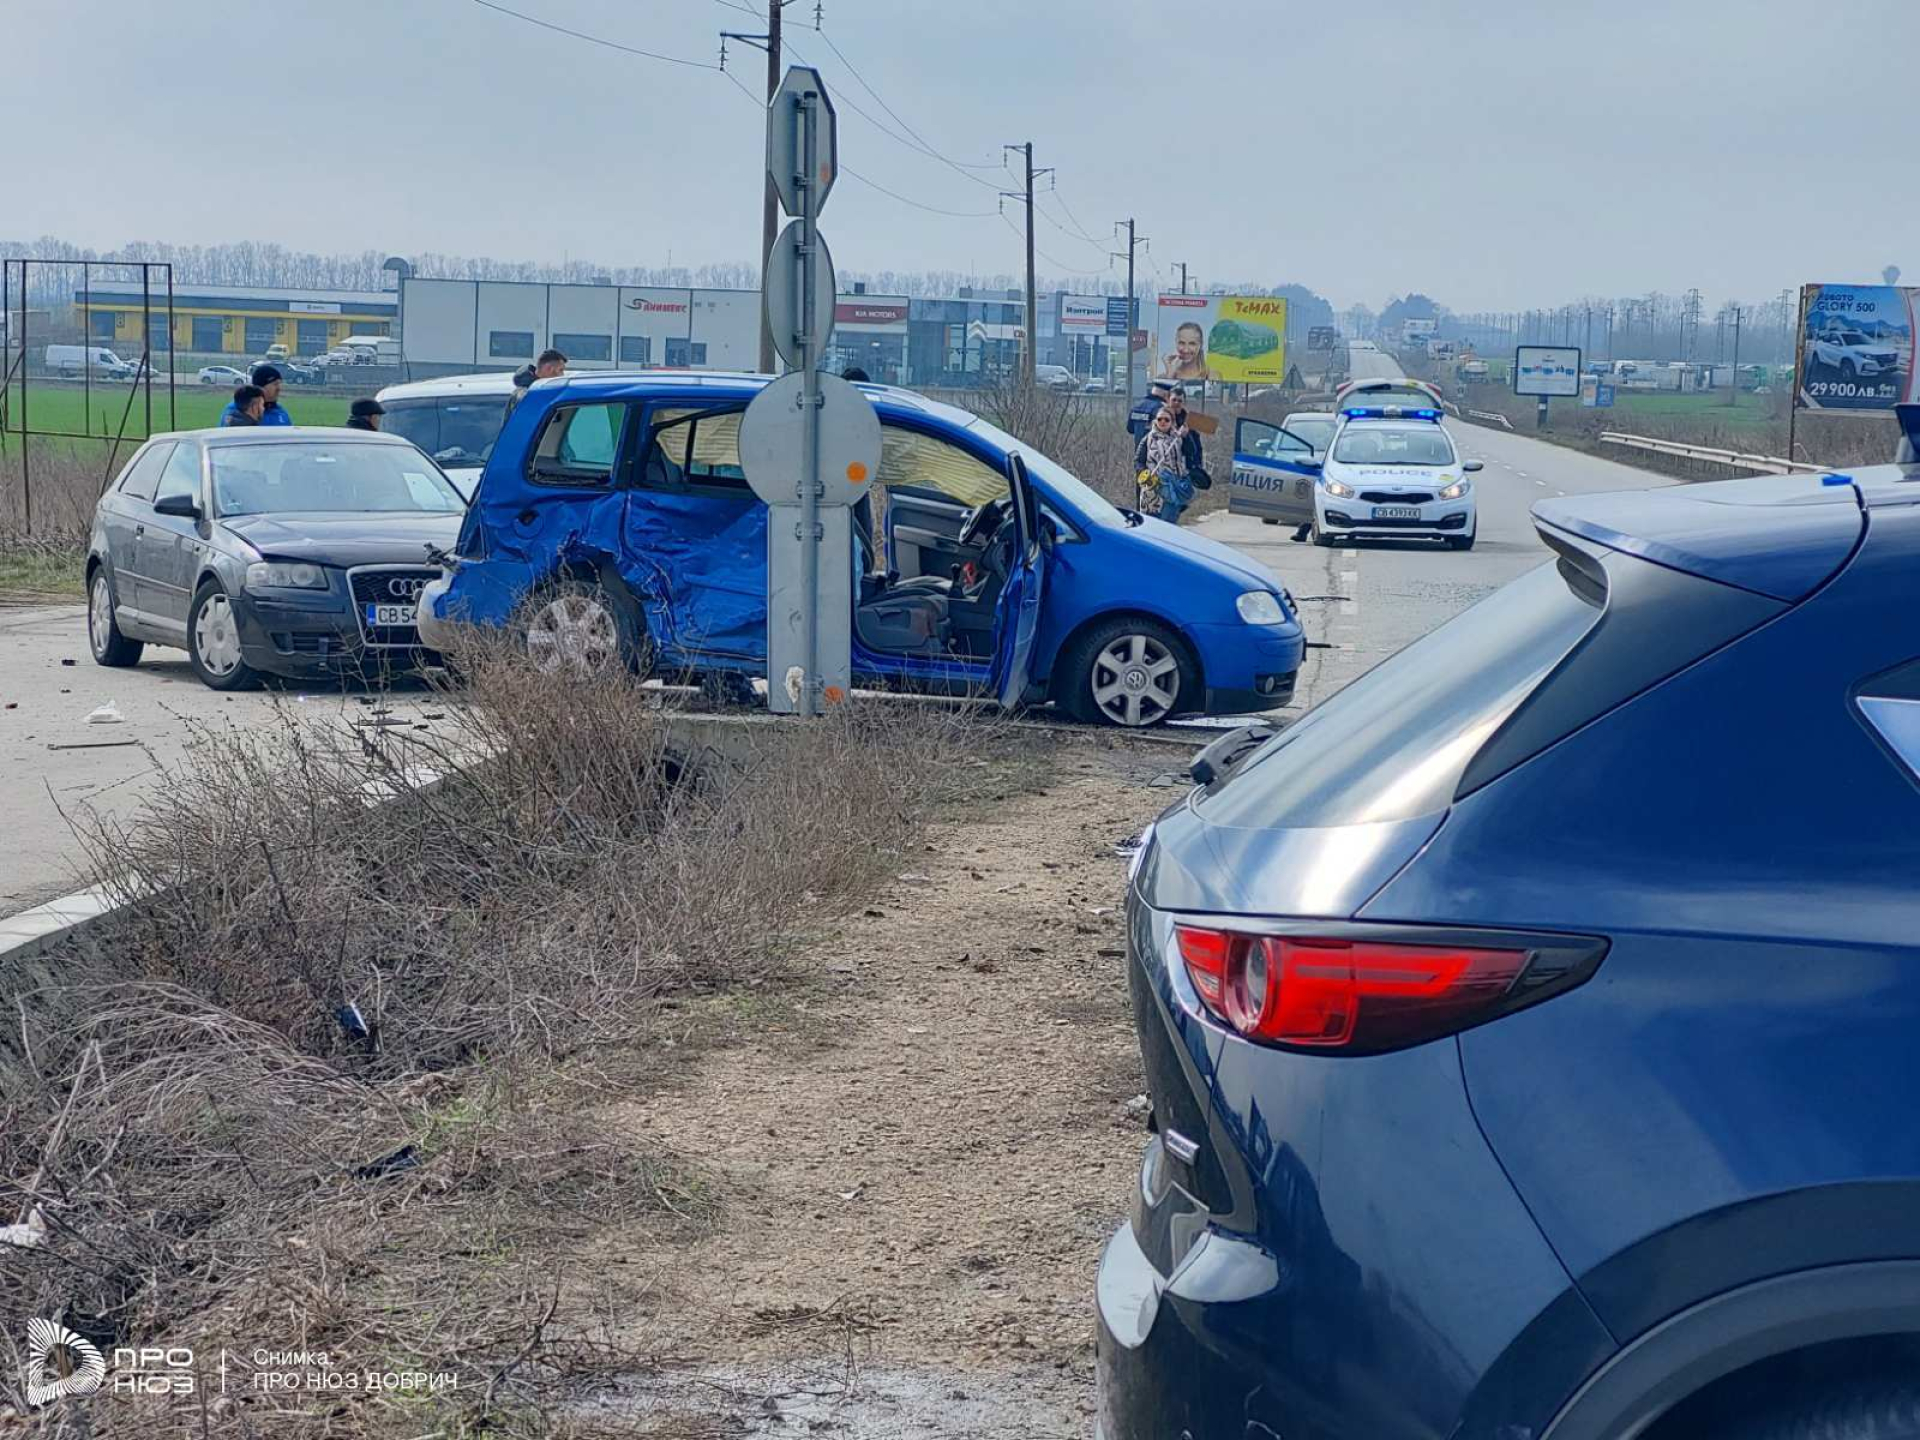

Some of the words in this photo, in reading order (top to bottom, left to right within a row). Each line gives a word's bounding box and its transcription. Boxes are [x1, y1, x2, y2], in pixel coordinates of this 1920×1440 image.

[1817, 301, 1854, 311] GLORY
[1856, 302, 1876, 312] 500
[1359, 469, 1433, 477] POLICE
